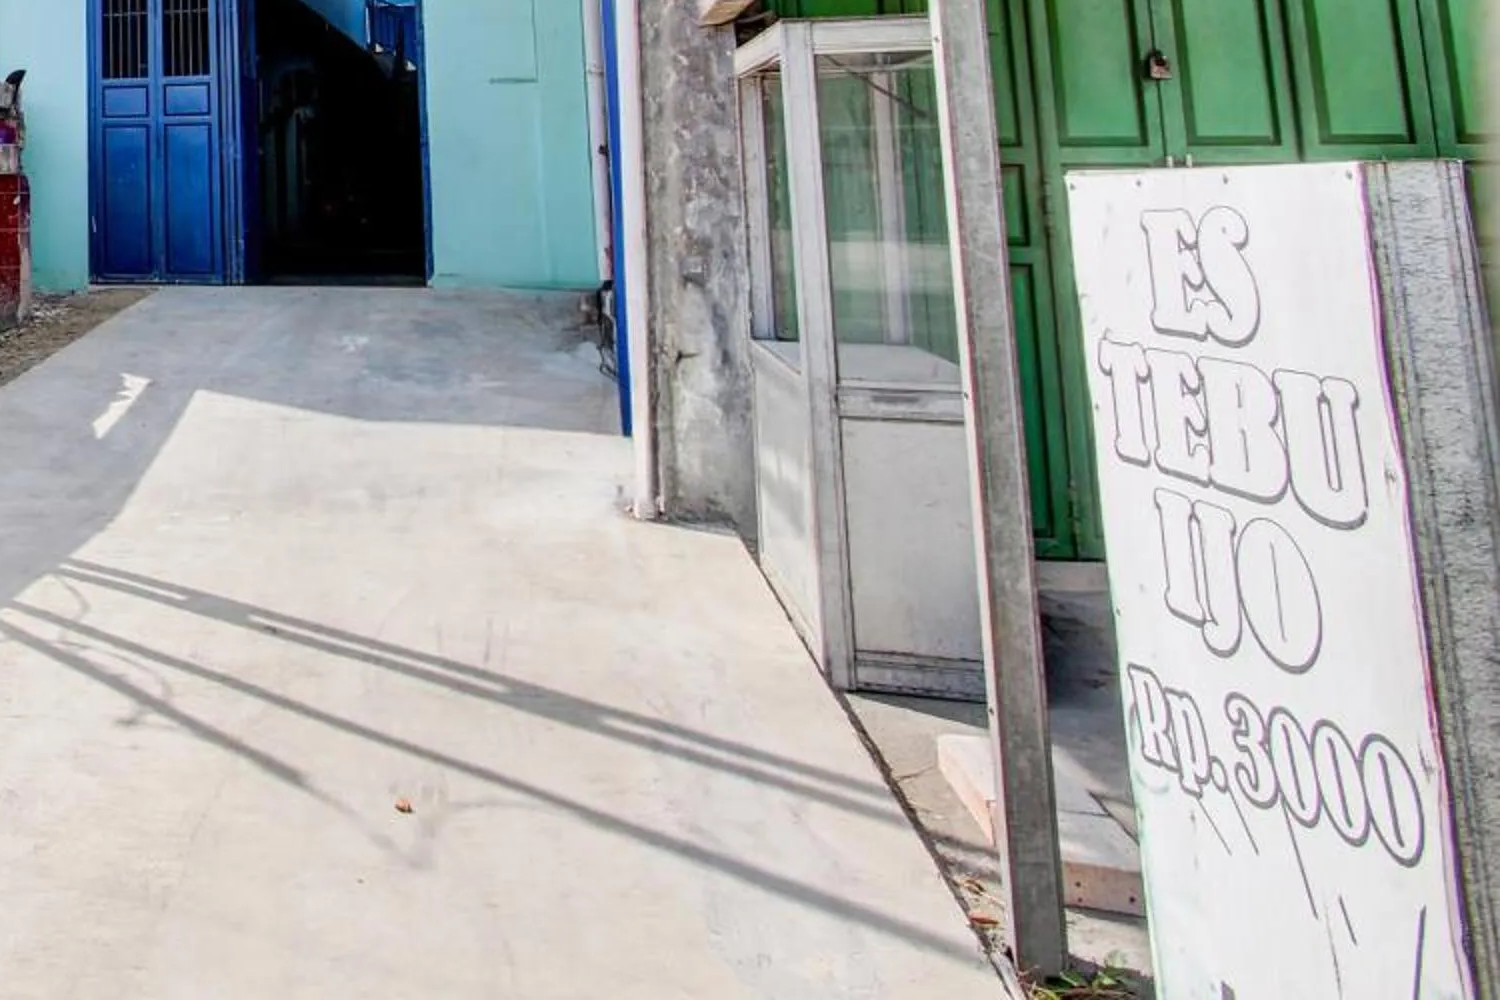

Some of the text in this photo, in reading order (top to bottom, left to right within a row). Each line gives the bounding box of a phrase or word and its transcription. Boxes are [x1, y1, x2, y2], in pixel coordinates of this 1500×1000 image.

[1141, 206, 1261, 349] ES
[1099, 329, 1369, 530] TEBU
[1153, 487, 1324, 675] IJO
